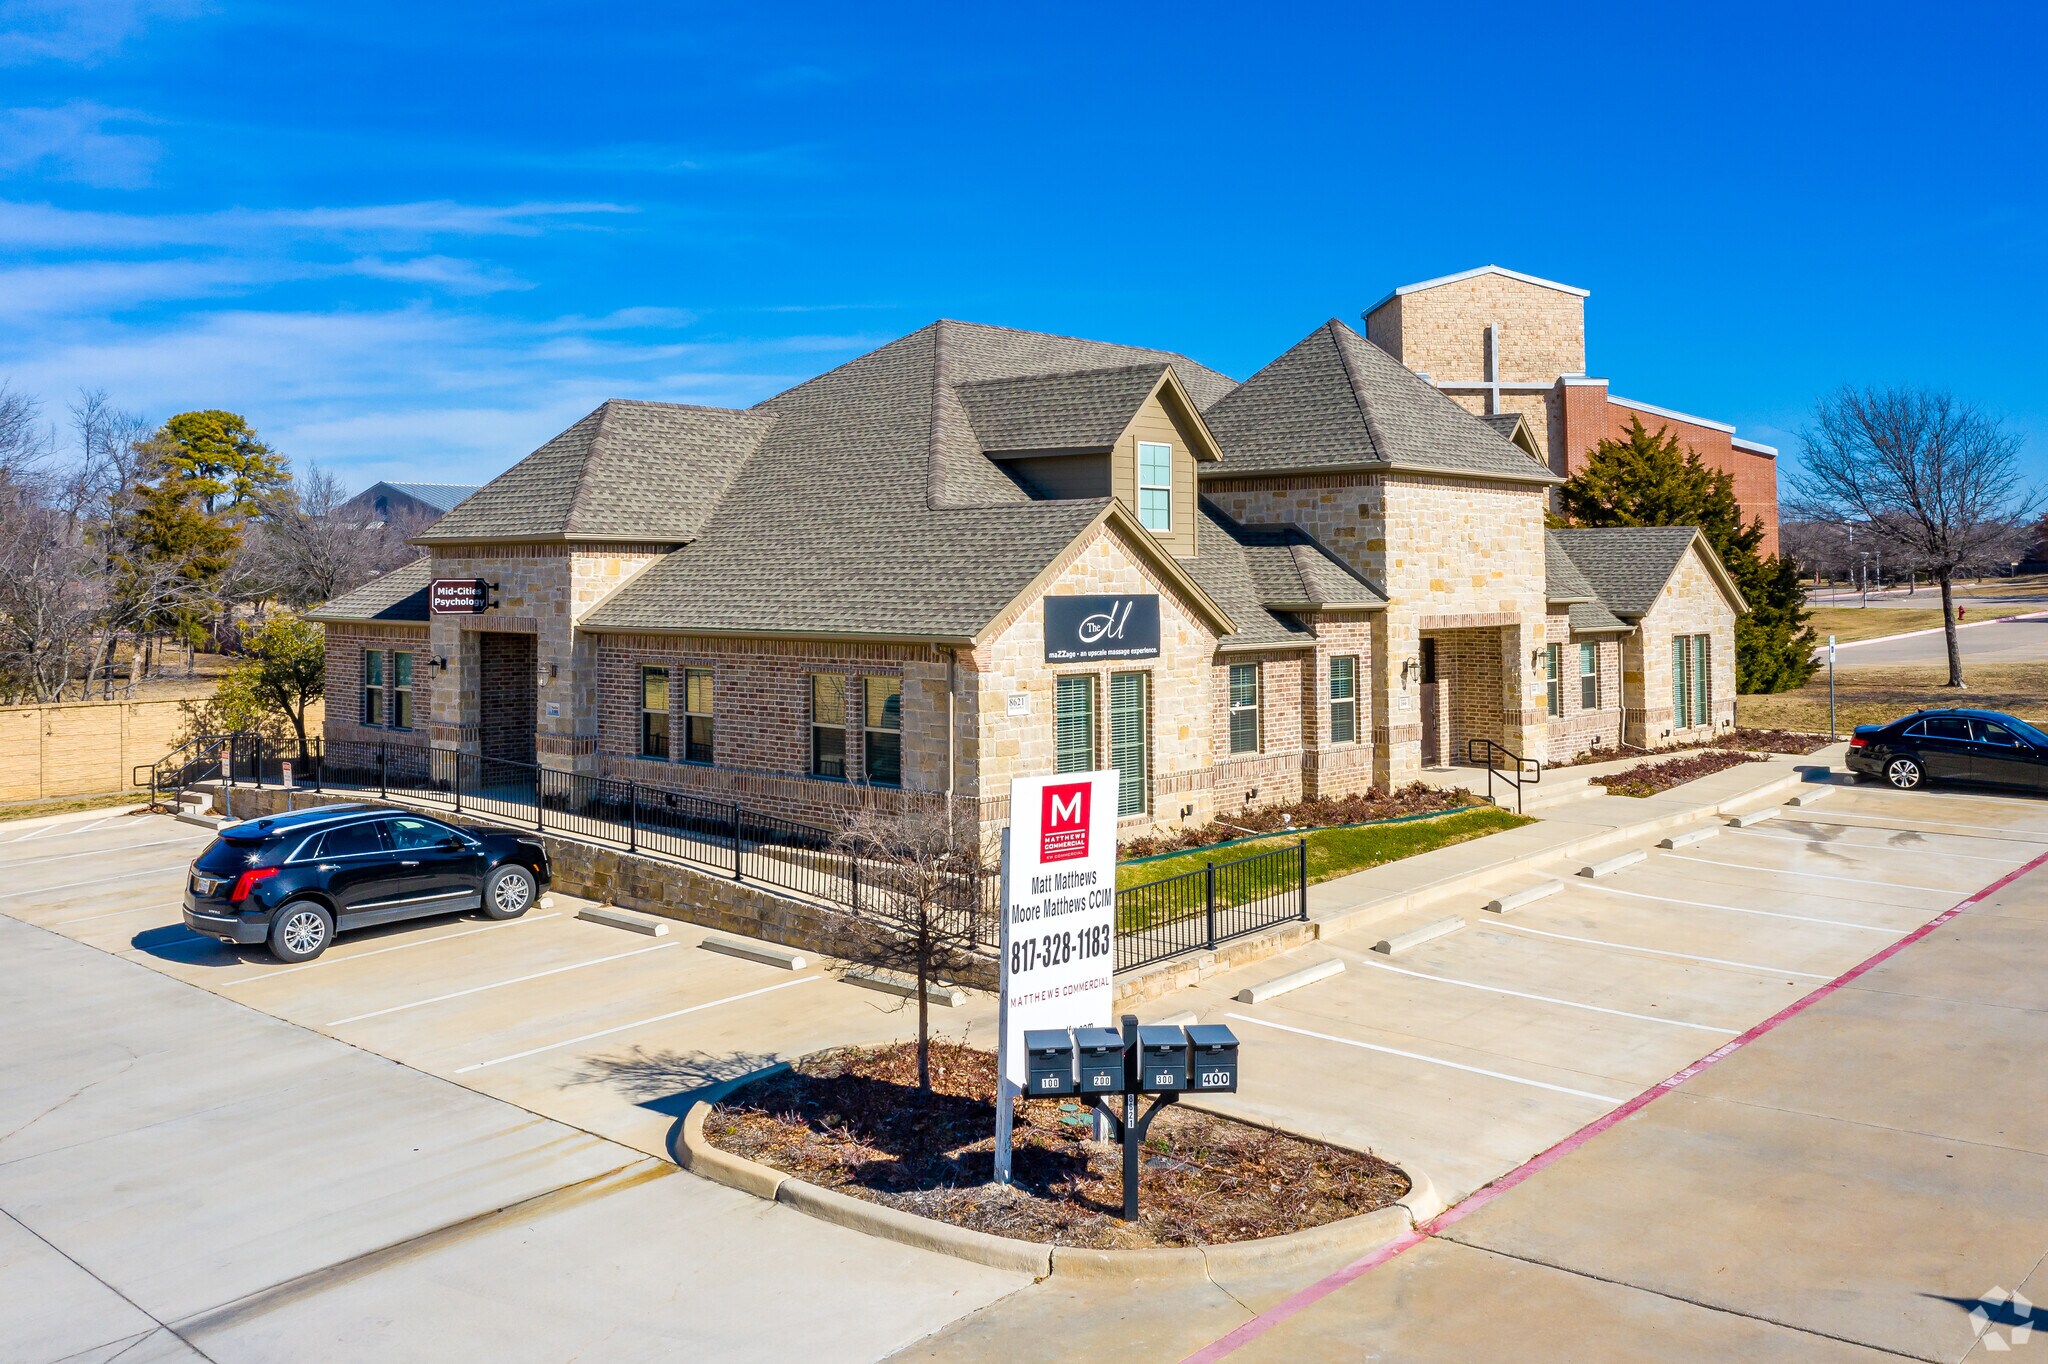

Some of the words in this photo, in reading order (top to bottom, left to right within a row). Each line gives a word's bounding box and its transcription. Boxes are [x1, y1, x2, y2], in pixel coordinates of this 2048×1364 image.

[437, 587, 482, 595] Mid-Cities
[434, 598, 484, 607] Psychology
[1087, 622, 1100, 632] The
[1049, 650, 1076, 659] maZZage
[1088, 649, 1107, 657] upscale
[1108, 648, 1130, 656] massage
[1009, 697, 1025, 706] 8621
[1051, 791, 1082, 827] M
[1044, 832, 1086, 843] MATTHEWS
[1044, 840, 1085, 850] COMMERCIAL
[1054, 851, 1084, 859] COMMERCIAL
[1031, 876, 1052, 895] Matt
[1054, 870, 1097, 891] Matthews
[1011, 904, 1041, 924] Moore
[1043, 896, 1086, 919] Matthews
[1088, 887, 1112, 910] CCIM
[1011, 923, 1110, 975] 817-328-1183
[1010, 987, 1060, 1008] MATTHEWS
[1063, 976, 1110, 997] COMMERCIAL
[1043, 1079, 1058, 1087] 100
[1094, 1077, 1110, 1085] 200
[1157, 1075, 1172, 1084] 300
[1203, 1073, 1229, 1085] 400
